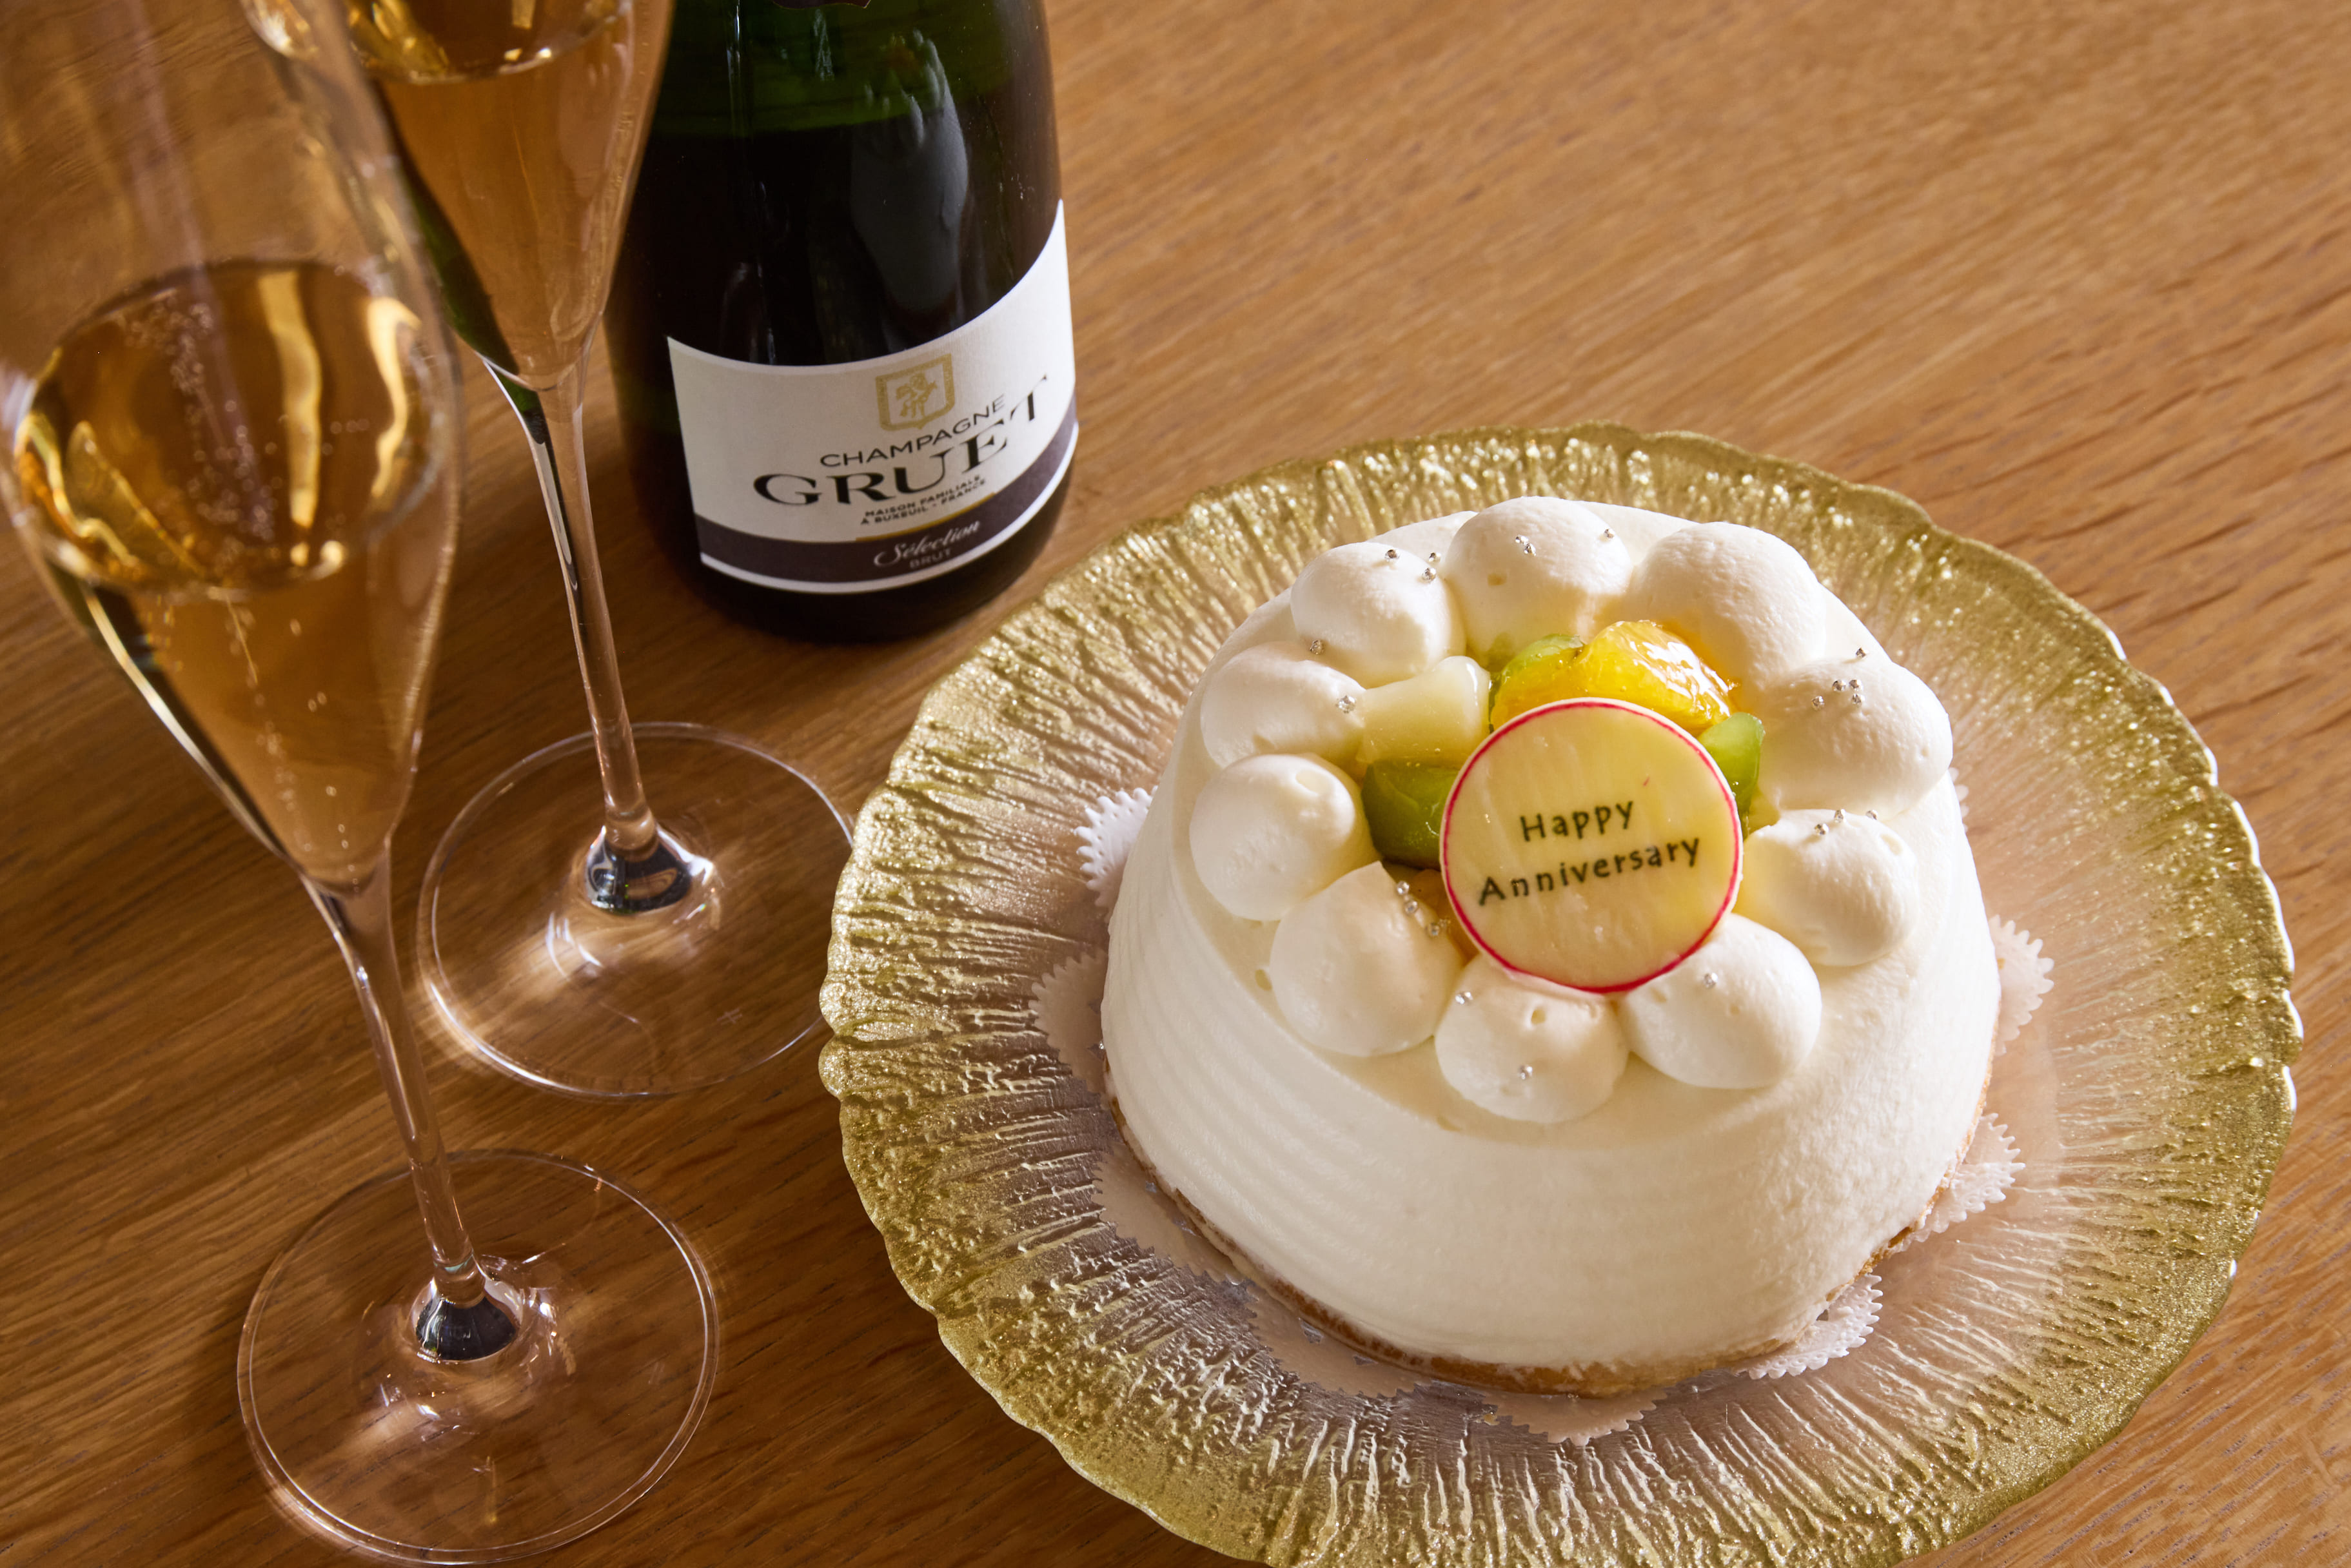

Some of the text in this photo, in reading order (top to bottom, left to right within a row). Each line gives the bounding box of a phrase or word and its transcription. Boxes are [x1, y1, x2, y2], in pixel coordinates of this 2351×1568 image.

[753, 373, 1048, 506] GRUET
[820, 394, 1005, 467] CHAMPAGNE
[865, 502, 916, 516] MAISON
[874, 507, 928, 523] BUXEUIL
[941, 479, 985, 504] FRANCE
[909, 549, 951, 568] BRUT
[1520, 800, 1634, 842] Happy
[1479, 838, 1700, 906] Anniversary
